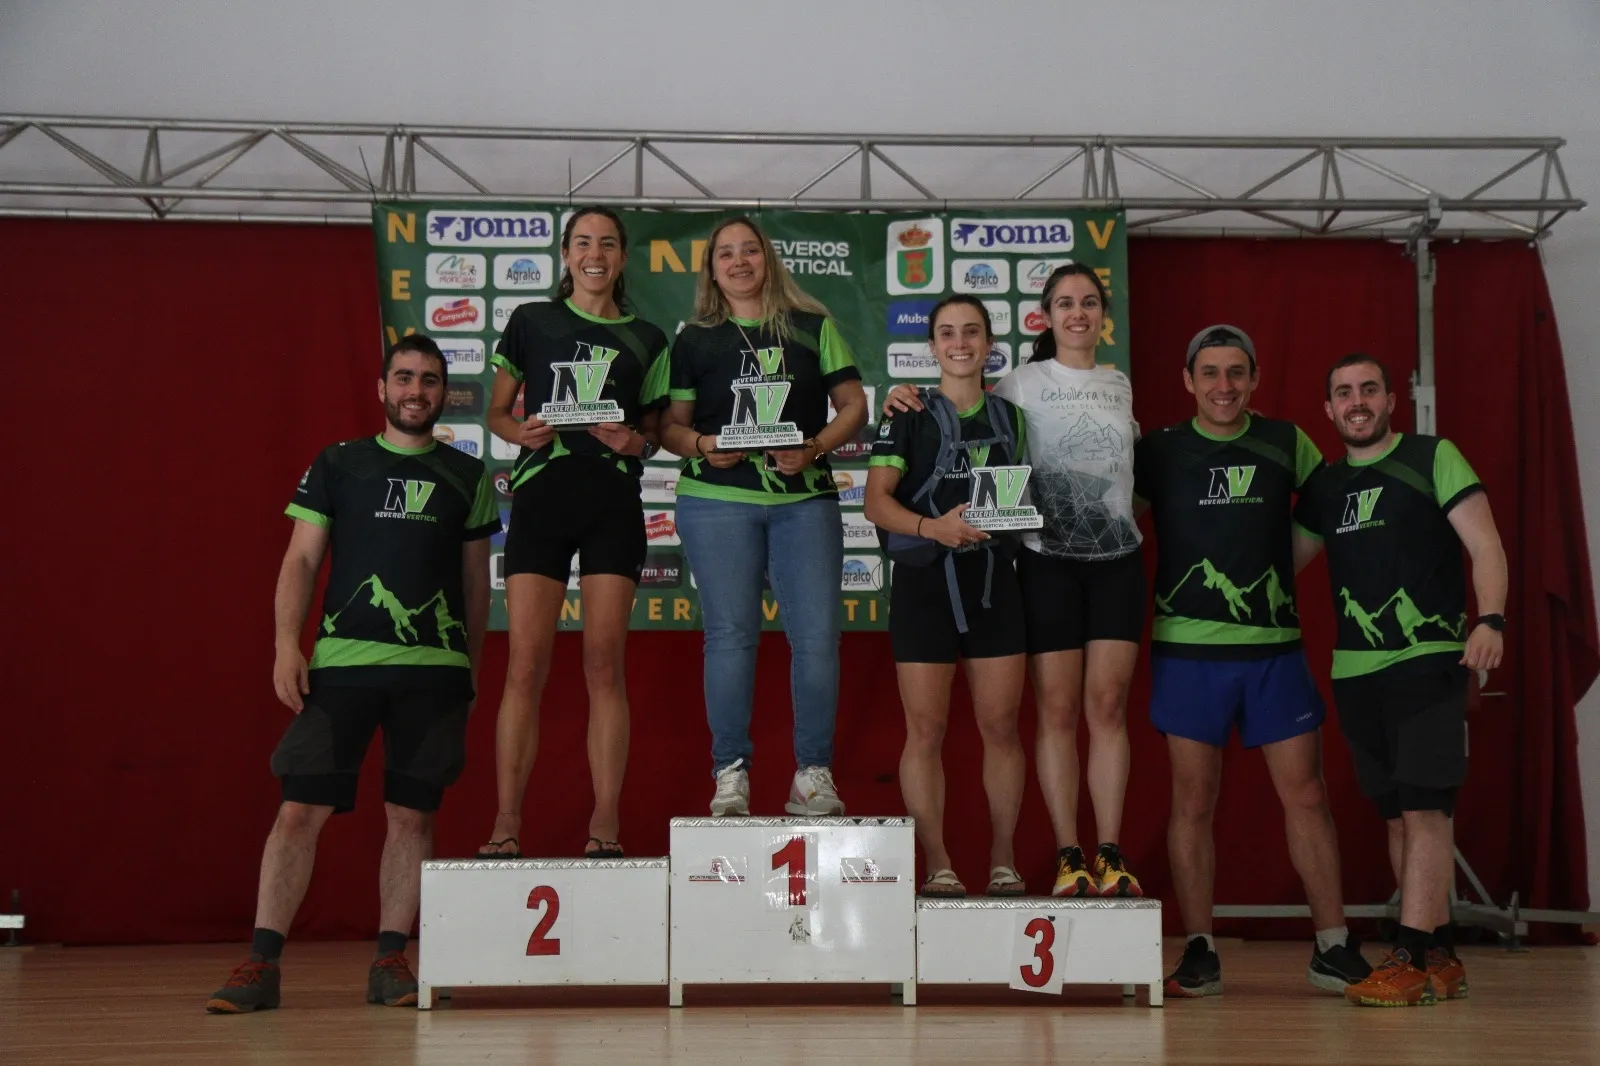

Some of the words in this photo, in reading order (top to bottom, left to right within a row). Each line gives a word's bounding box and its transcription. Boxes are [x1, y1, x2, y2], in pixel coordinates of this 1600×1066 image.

[506, 267, 541, 285] Agralco
[782, 258, 853, 276] RTICAL
[964, 271, 999, 289] Agralco
[1041, 387, 1099, 402] Cebollera
[723, 426, 759, 436] NEVEROS
[1208, 465, 1257, 499] NV
[384, 478, 437, 513] NV
[1198, 497, 1231, 506] NEVEROS
[374, 511, 406, 519] NEVEROS
[964, 509, 998, 519] NEVEROS
[1342, 486, 1384, 526] NV
[771, 836, 806, 906] 1
[525, 884, 561, 956] 2
[1019, 917, 1056, 988] 3
